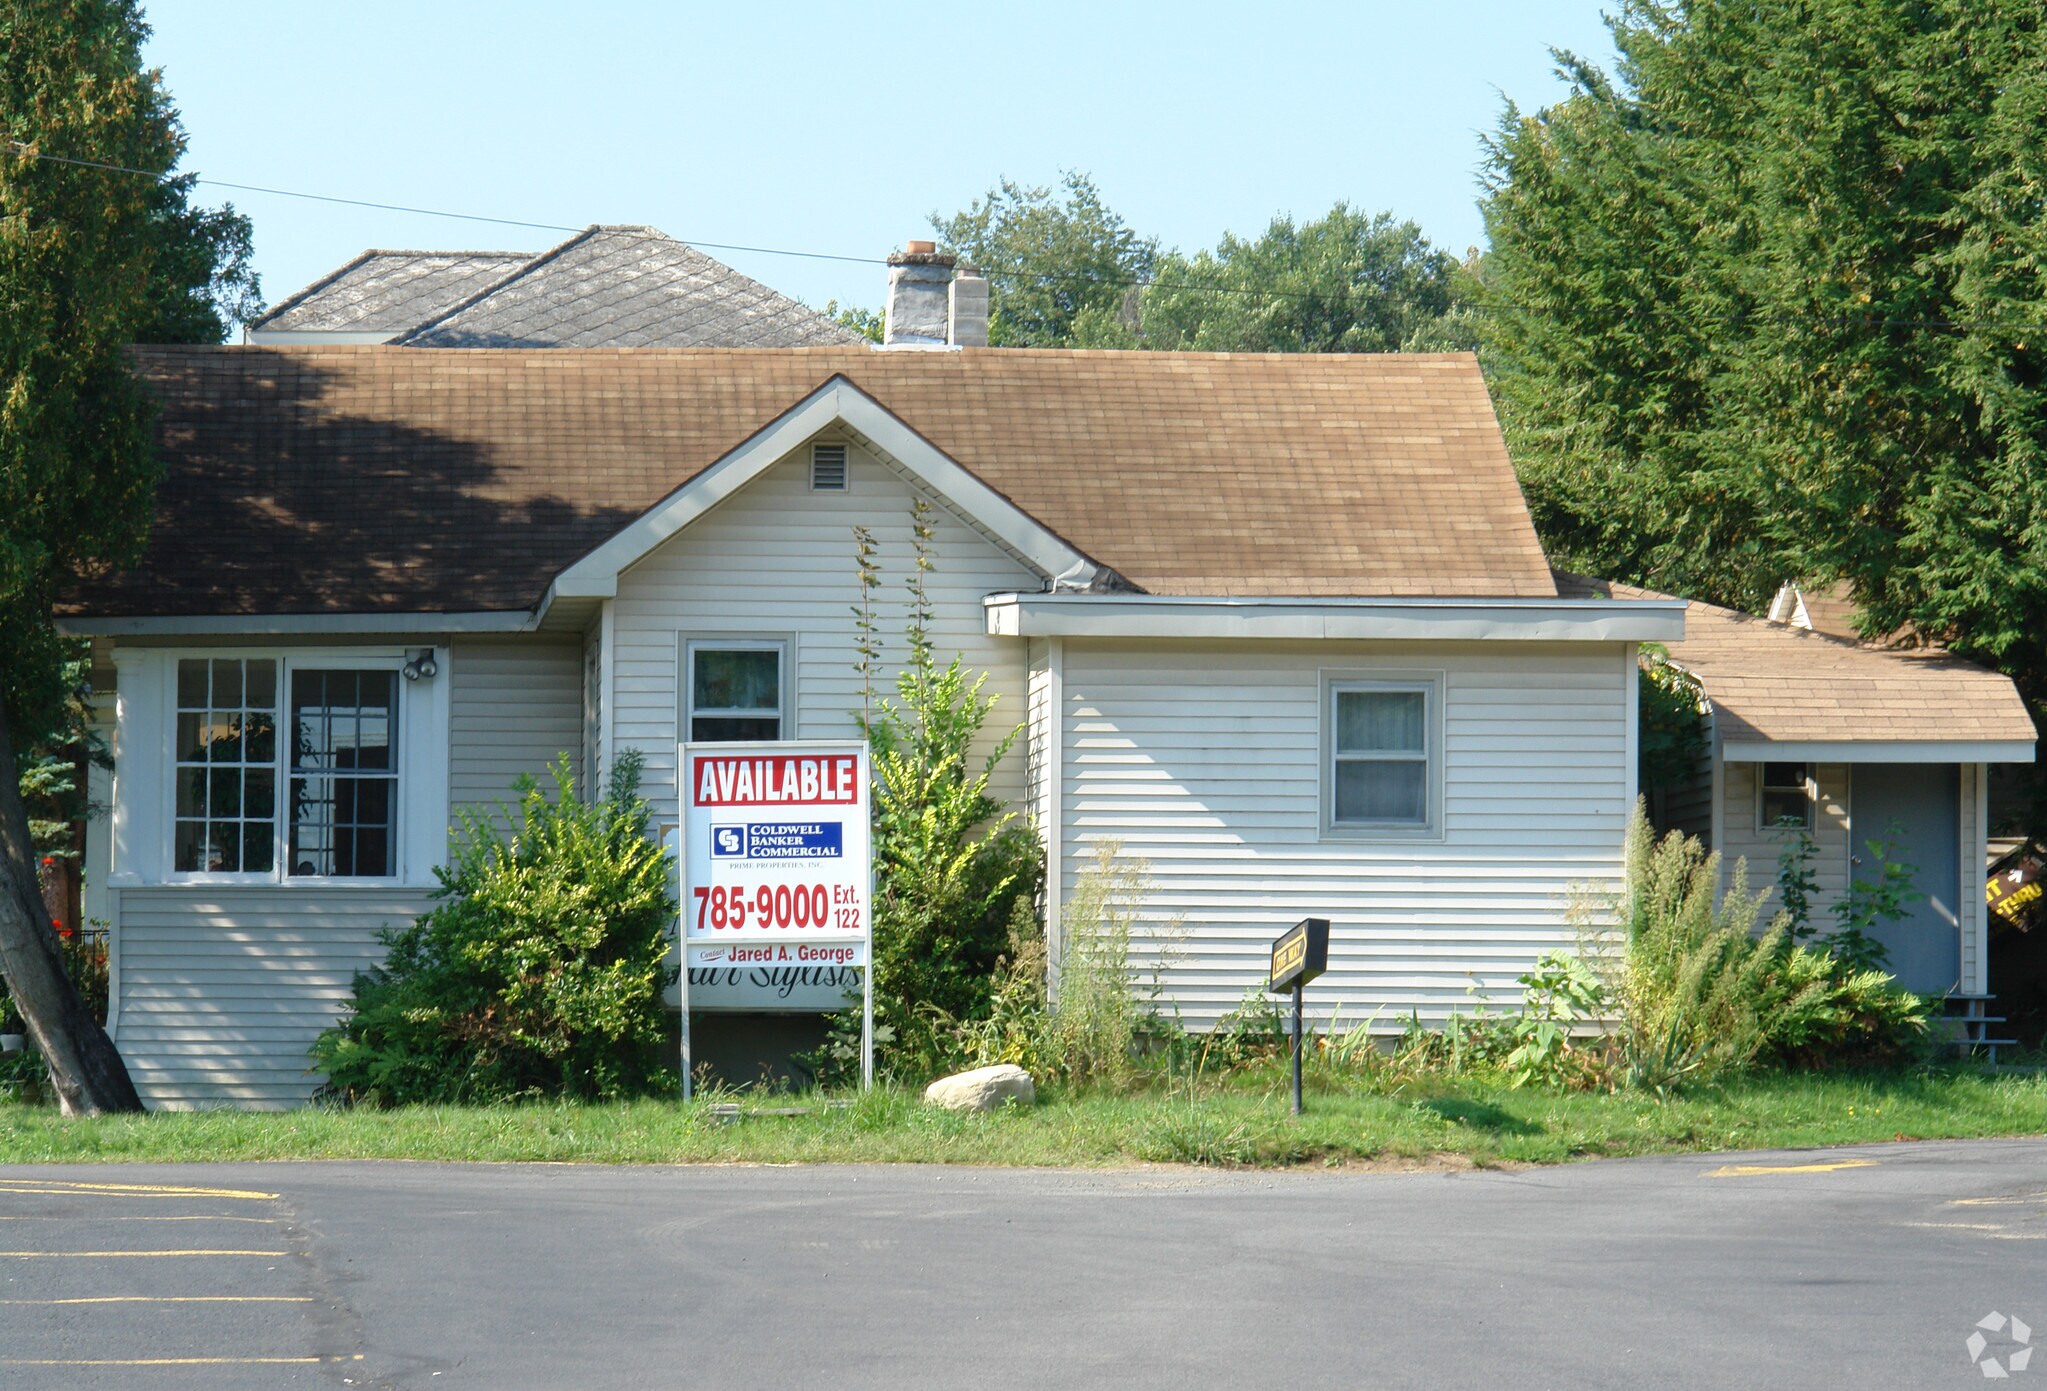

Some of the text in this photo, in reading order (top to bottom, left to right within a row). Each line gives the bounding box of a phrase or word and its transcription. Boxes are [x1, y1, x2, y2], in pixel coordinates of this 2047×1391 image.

[699, 760, 852, 802] AVAILABLE
[750, 824, 823, 836] COLDWELL
[750, 836, 804, 846] BANKER
[750, 846, 839, 857] COMMERCIAL
[729, 862, 754, 870] PRIME
[756, 861, 806, 870] PROPERTIES,
[834, 884, 860, 904] Ext.
[694, 883, 829, 930] 785-9000
[834, 908, 860, 929] 122
[699, 945, 855, 964] Contact Jared A. George
[665, 963, 742, 986] air
